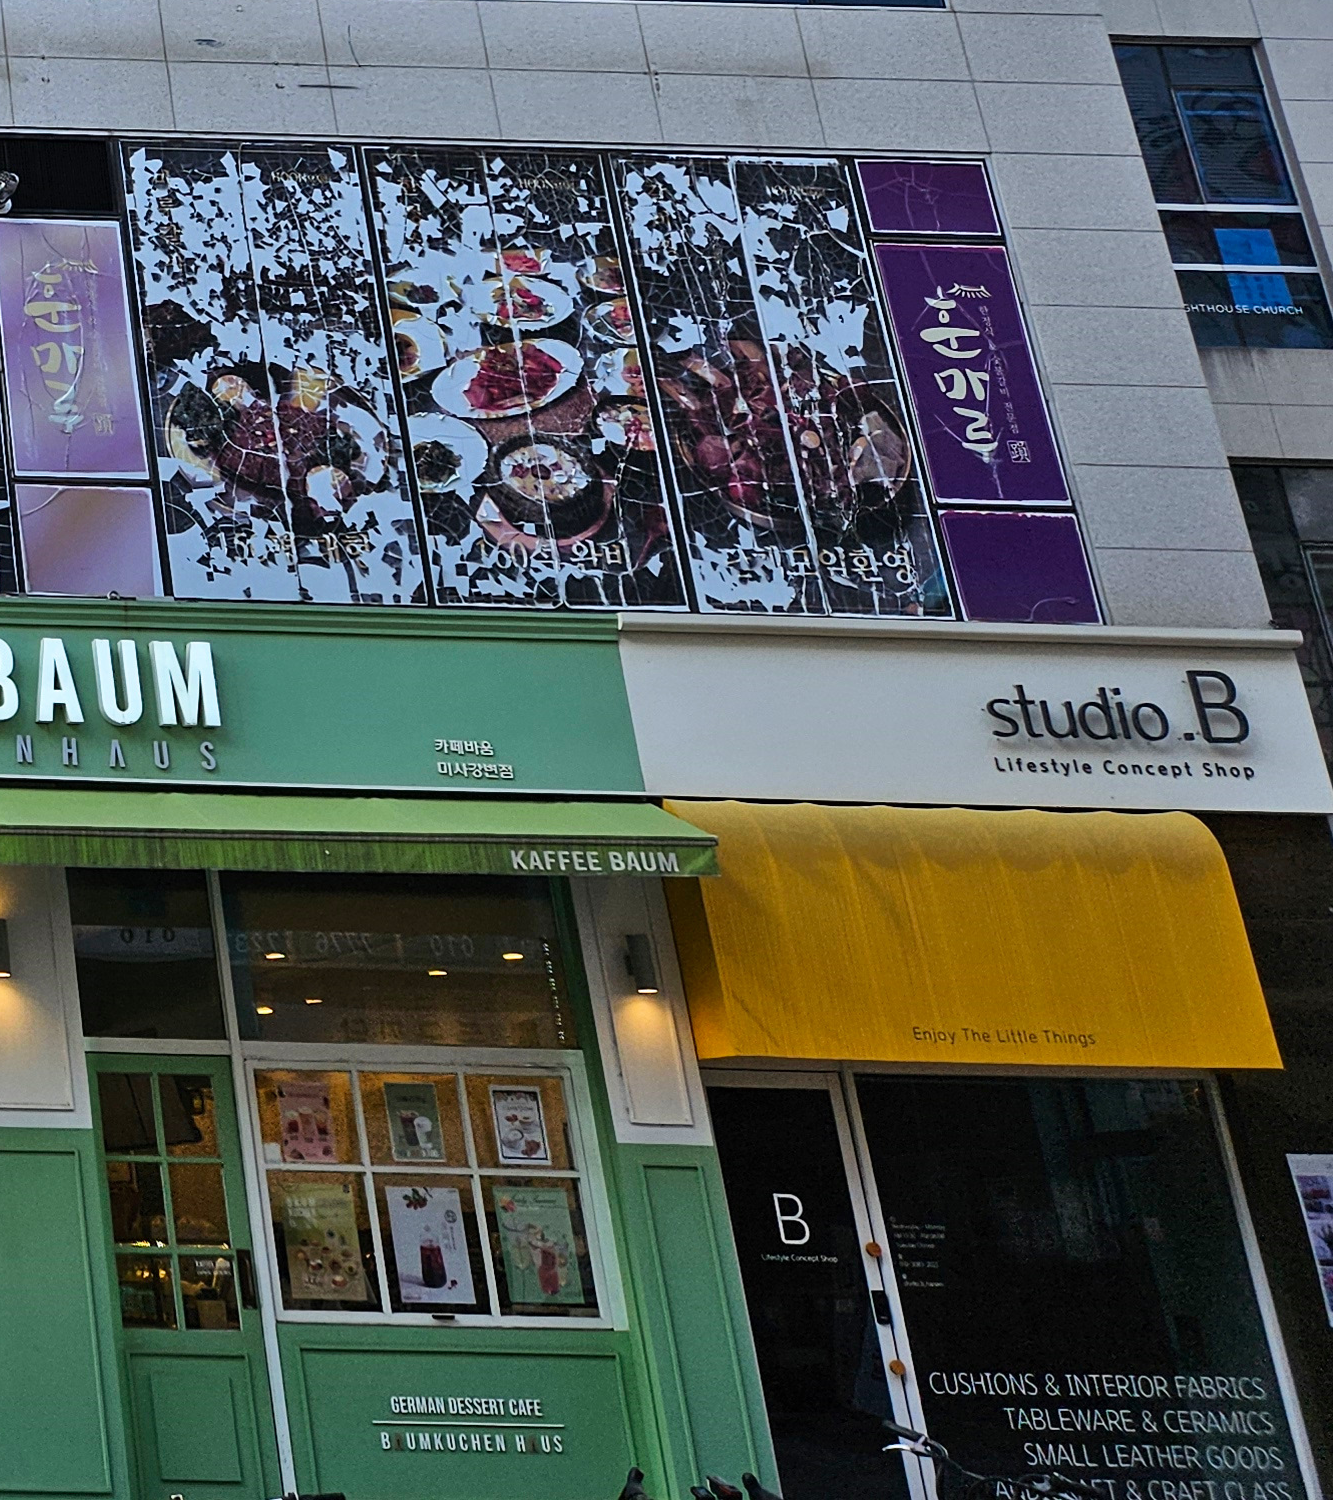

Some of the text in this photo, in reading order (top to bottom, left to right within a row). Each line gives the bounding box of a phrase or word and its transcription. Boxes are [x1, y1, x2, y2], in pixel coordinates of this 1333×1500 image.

[1183, 303, 1304, 316] GHTHOUSE CHURCH
[434, 737, 495, 758] 카페바움
[436, 760, 515, 781] 미사강변점
[993, 756, 1256, 782] Lifestyle Concept Shop
[510, 848, 681, 874] KAFFEE BAUM
[912, 1025, 1097, 1048] Enjoy The Little Things
[772, 1192, 812, 1246] B
[790, 1253, 820, 1263] Concept
[820, 1254, 839, 1264] Shop
[928, 1370, 1267, 1401] CUSHIONS & INTERIOR FABRICS
[390, 1396, 544, 1417] GERMAN DESSERT CAFE
[1006, 1406, 1275, 1436] TABLEWARE & CERAMICS
[1023, 1442, 1285, 1471] SMALL LEATHER GOODS
[1127, 1479, 1143, 1500] &
[1147, 1479, 1219, 1500] CRAFT
[1224, 1480, 1289, 1500] CLASS
